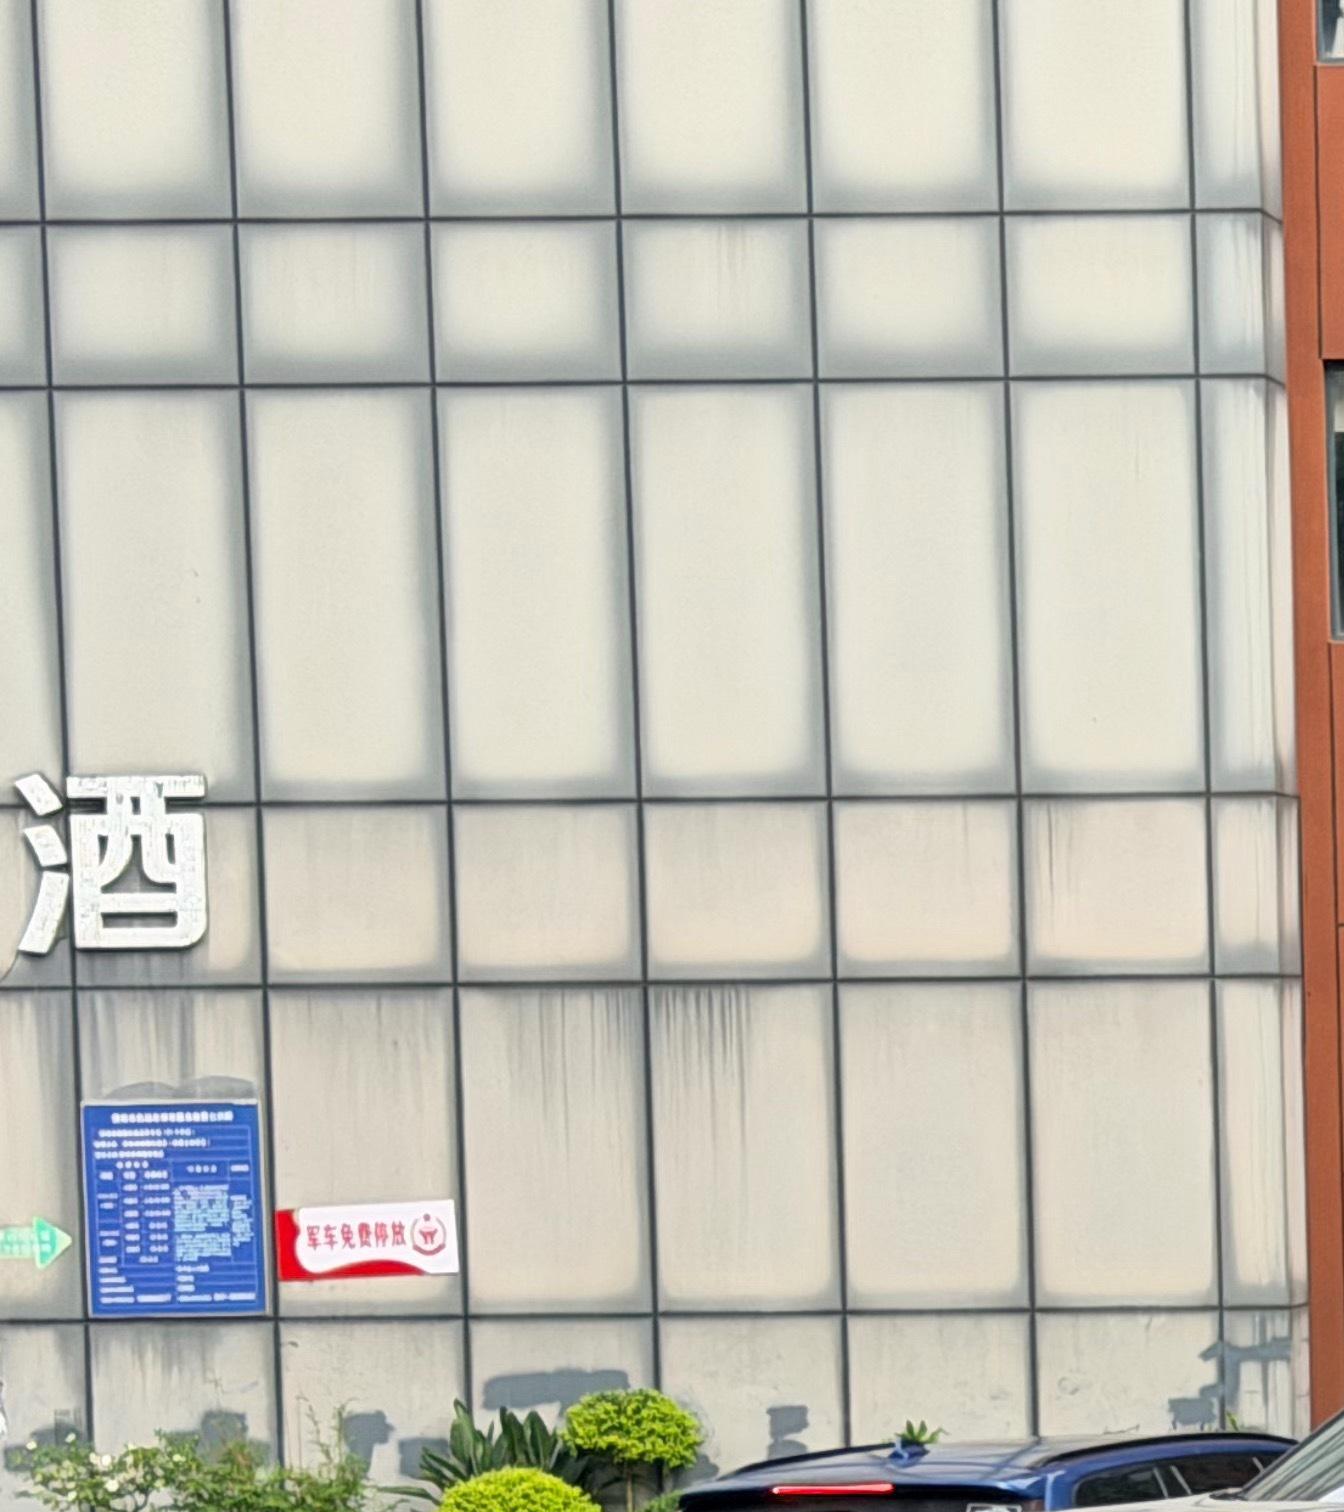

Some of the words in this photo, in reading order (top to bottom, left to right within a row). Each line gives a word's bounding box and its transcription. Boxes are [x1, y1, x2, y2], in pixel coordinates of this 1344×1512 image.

[13, 773, 208, 953] 酒
[306, 1210, 407, 1251] 军车免费停放
